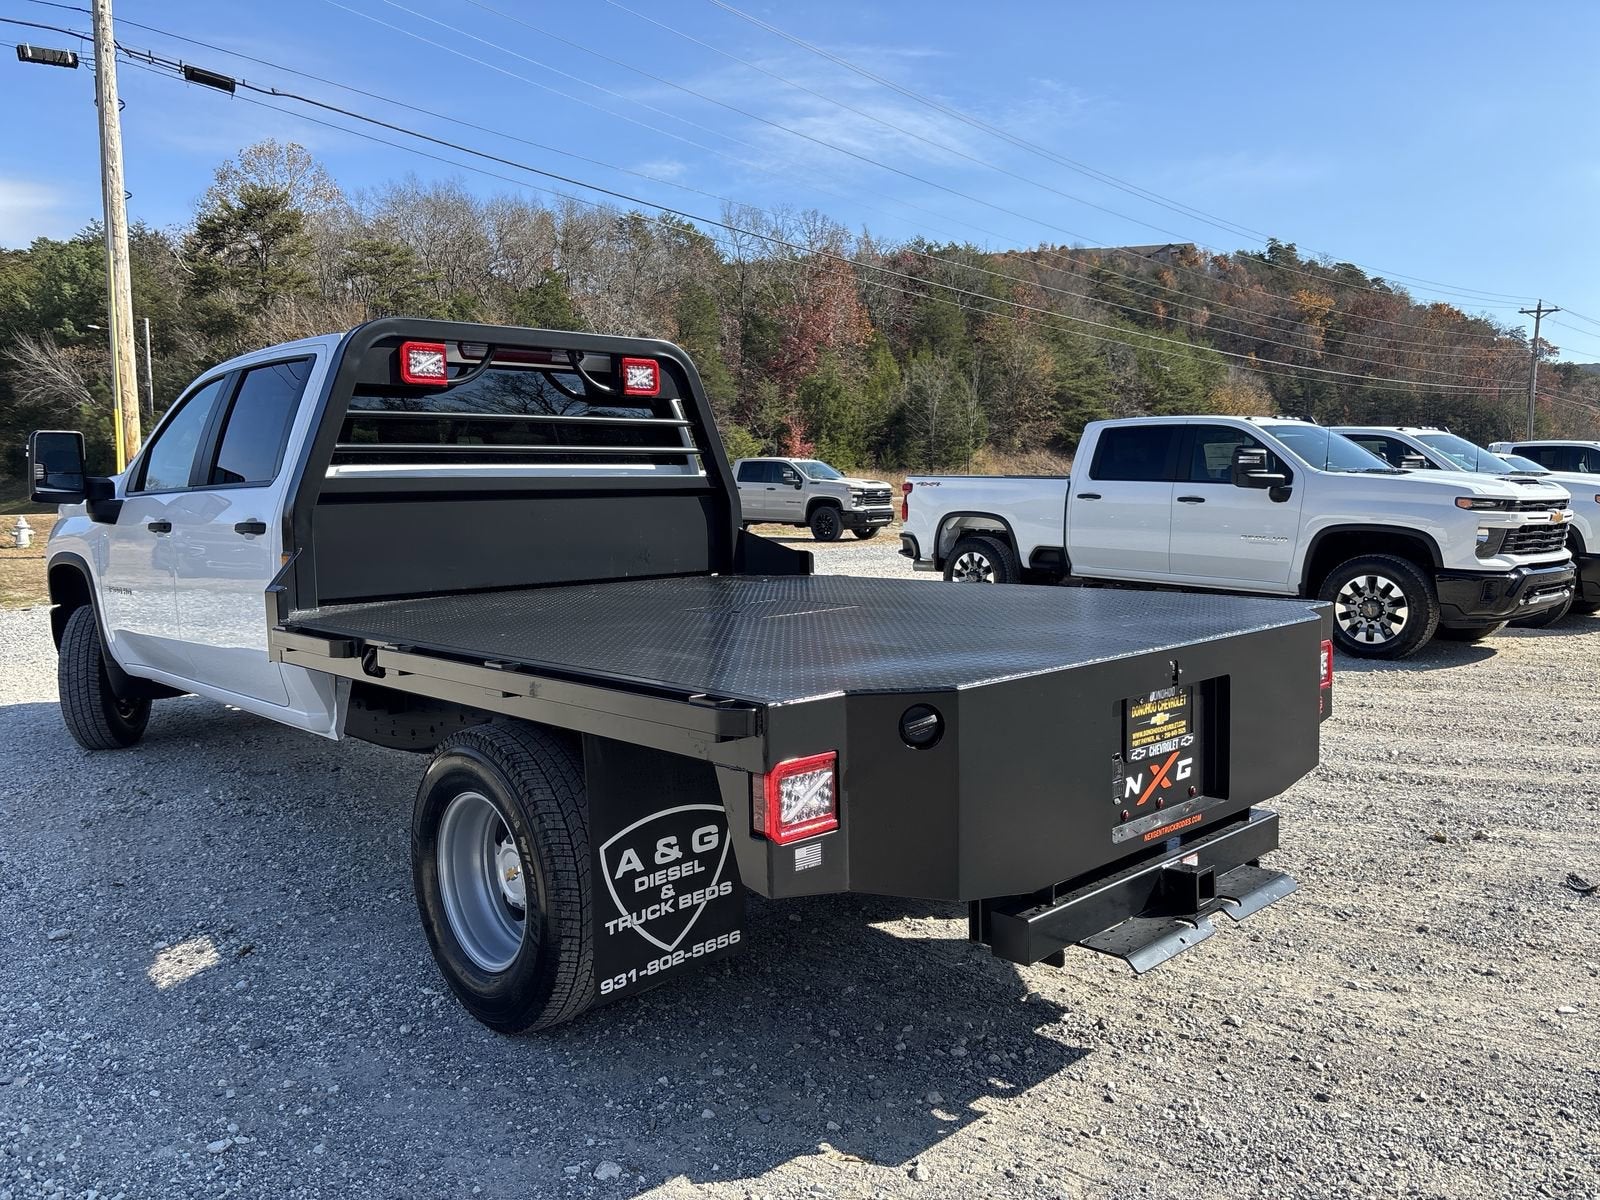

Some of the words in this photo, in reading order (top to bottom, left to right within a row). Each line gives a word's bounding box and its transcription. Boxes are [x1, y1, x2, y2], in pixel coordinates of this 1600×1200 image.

[1131, 701, 1157, 719] DONOHOO
[1158, 694, 1187, 713] CHEVROLET
[1149, 738, 1179, 757] CHEVROLET
[614, 848, 645, 880] A
[654, 835, 683, 865] &
[691, 824, 719, 853] G
[634, 859, 706, 893] DIESEL
[660, 884, 676, 900] &
[604, 899, 675, 936] TRUCK
[678, 881, 733, 910] BEDS
[600, 929, 742, 995] 931-802-5656
